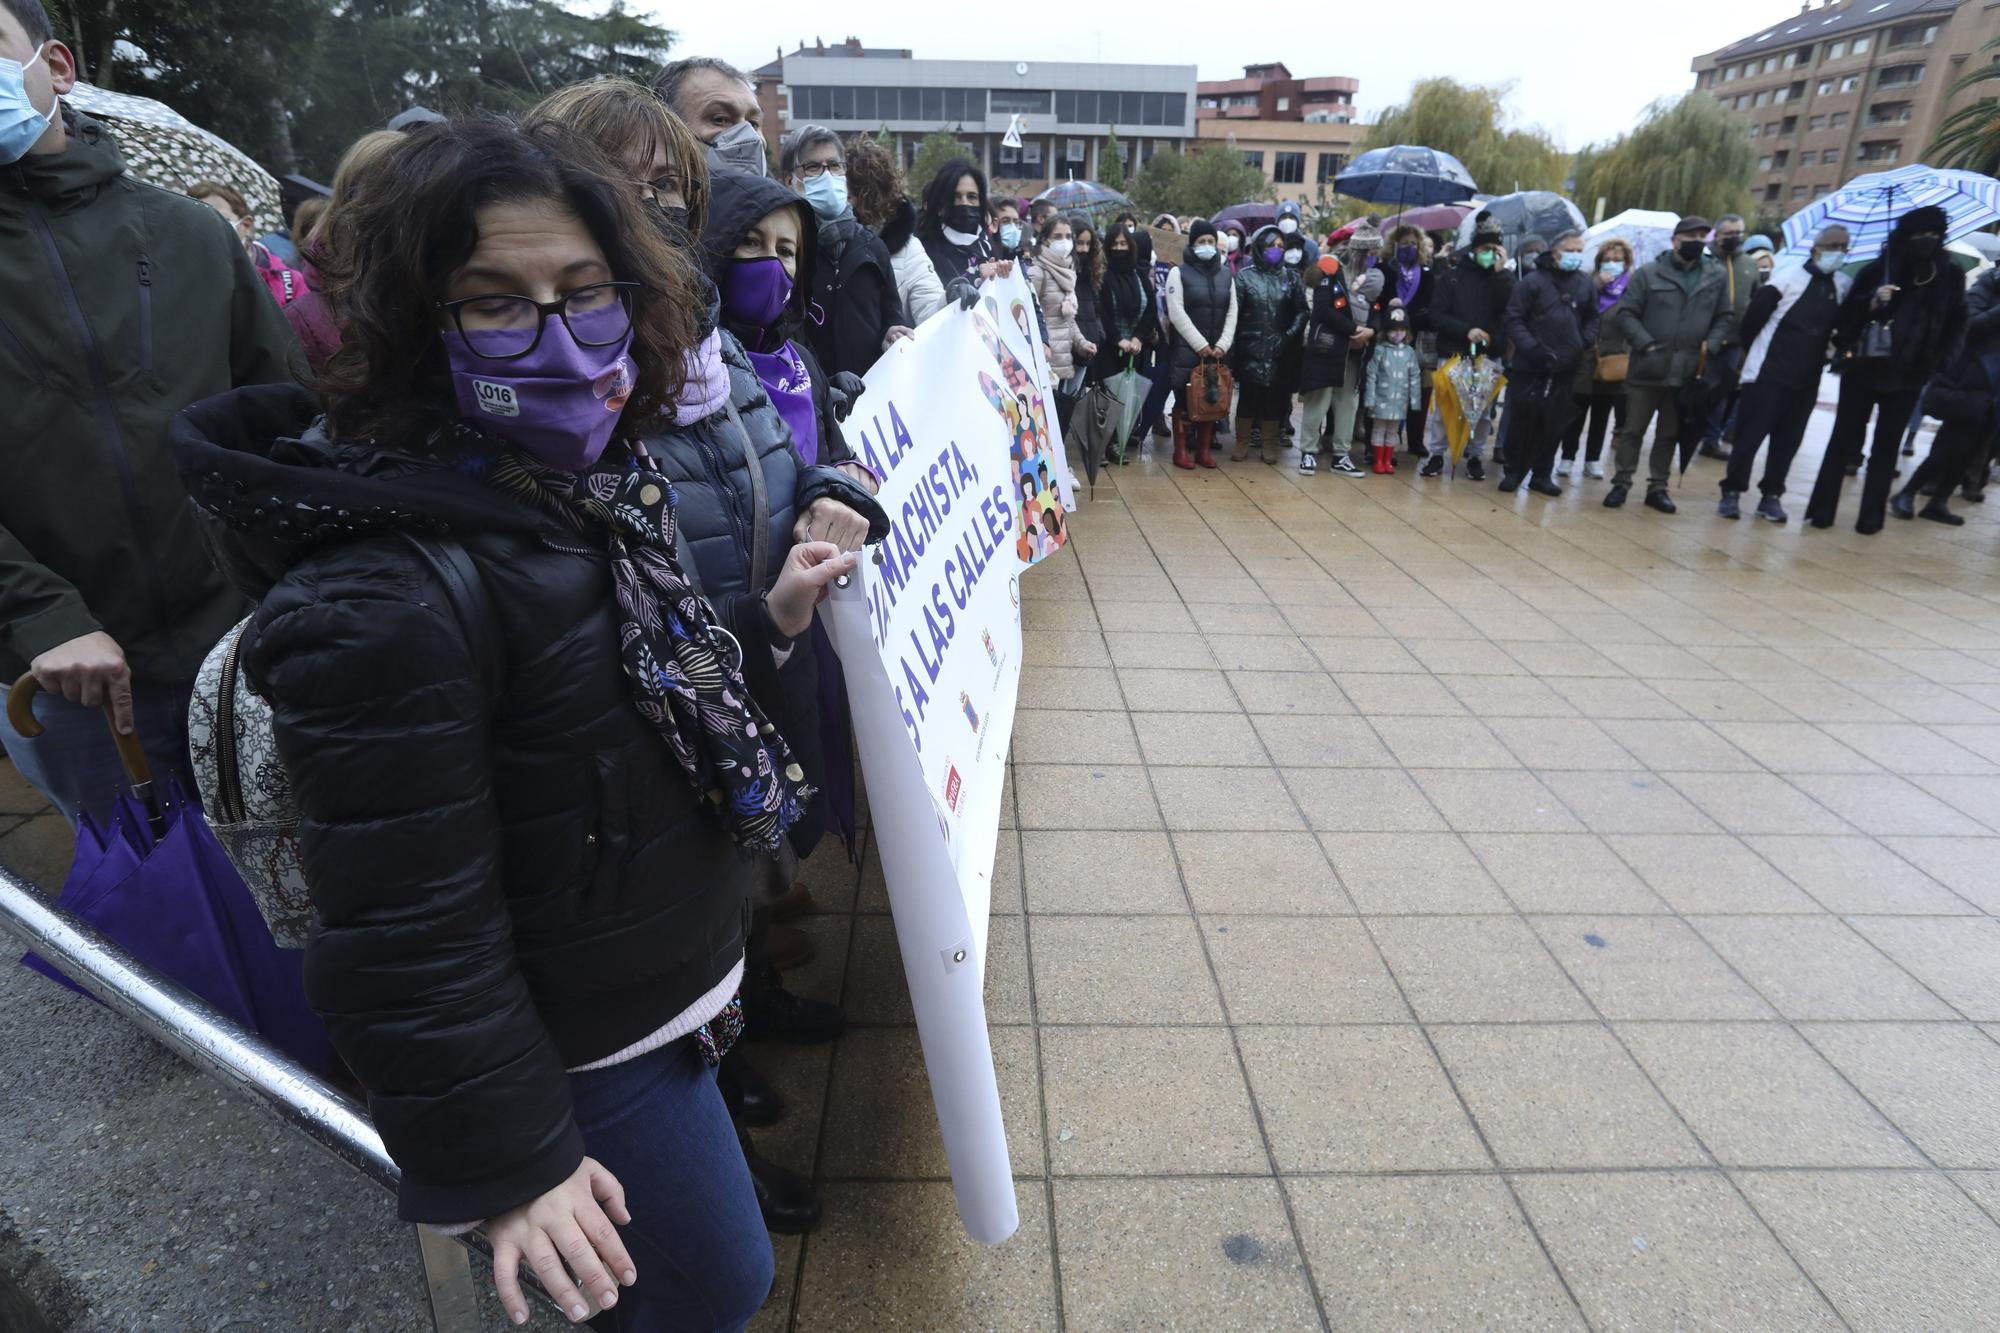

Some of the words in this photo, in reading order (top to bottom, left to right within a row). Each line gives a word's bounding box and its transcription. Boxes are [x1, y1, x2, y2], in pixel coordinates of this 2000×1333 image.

[484, 384, 511, 403] 016
[873, 400, 914, 471] LA
[879, 440, 980, 608] MACHISTA,
[944, 485, 1014, 611] CALLES
[911, 583, 957, 686] LAS
[900, 655, 930, 723] A
